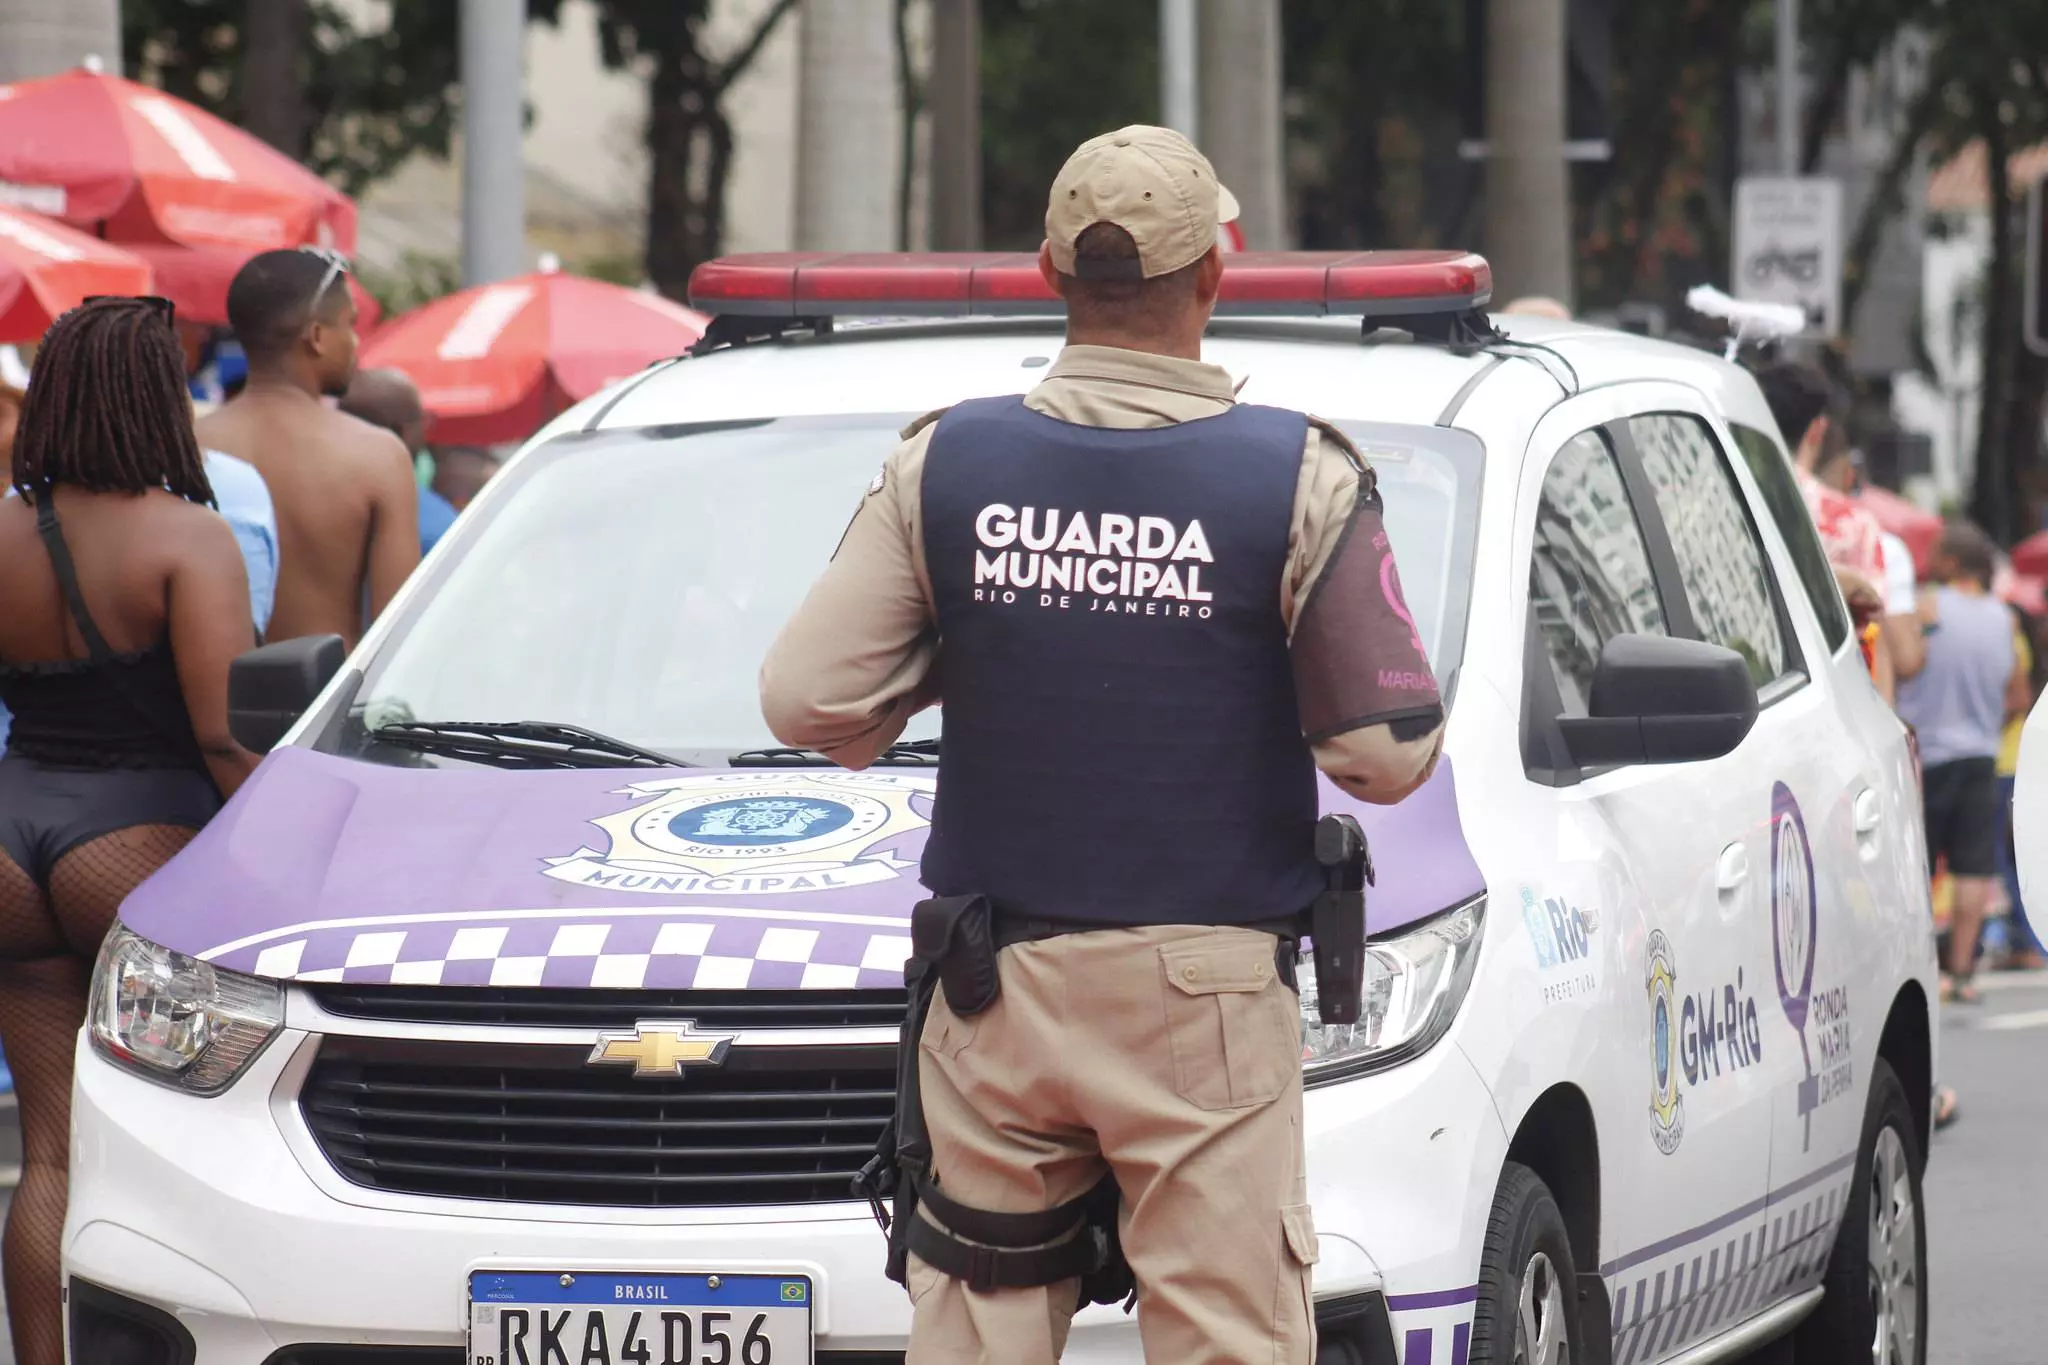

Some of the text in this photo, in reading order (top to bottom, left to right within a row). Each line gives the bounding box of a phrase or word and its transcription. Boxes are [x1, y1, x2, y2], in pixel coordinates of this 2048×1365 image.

[975, 503, 1214, 562] GUARDA
[974, 549, 1213, 601] MUNICIPAL
[974, 588, 1212, 619] RIO DE JANEIRO
[684, 845, 787, 855] RIO 1993
[583, 869, 847, 892] MUNICIPAL
[1544, 895, 1588, 963] Rio
[1544, 973, 1596, 1004] PREFEITURA
[1812, 984, 1848, 1028] RONDA
[1680, 965, 1761, 1086] GM-Rio
[615, 1284, 668, 1300] BRASIL
[500, 1308, 772, 1365] RKA4D56
